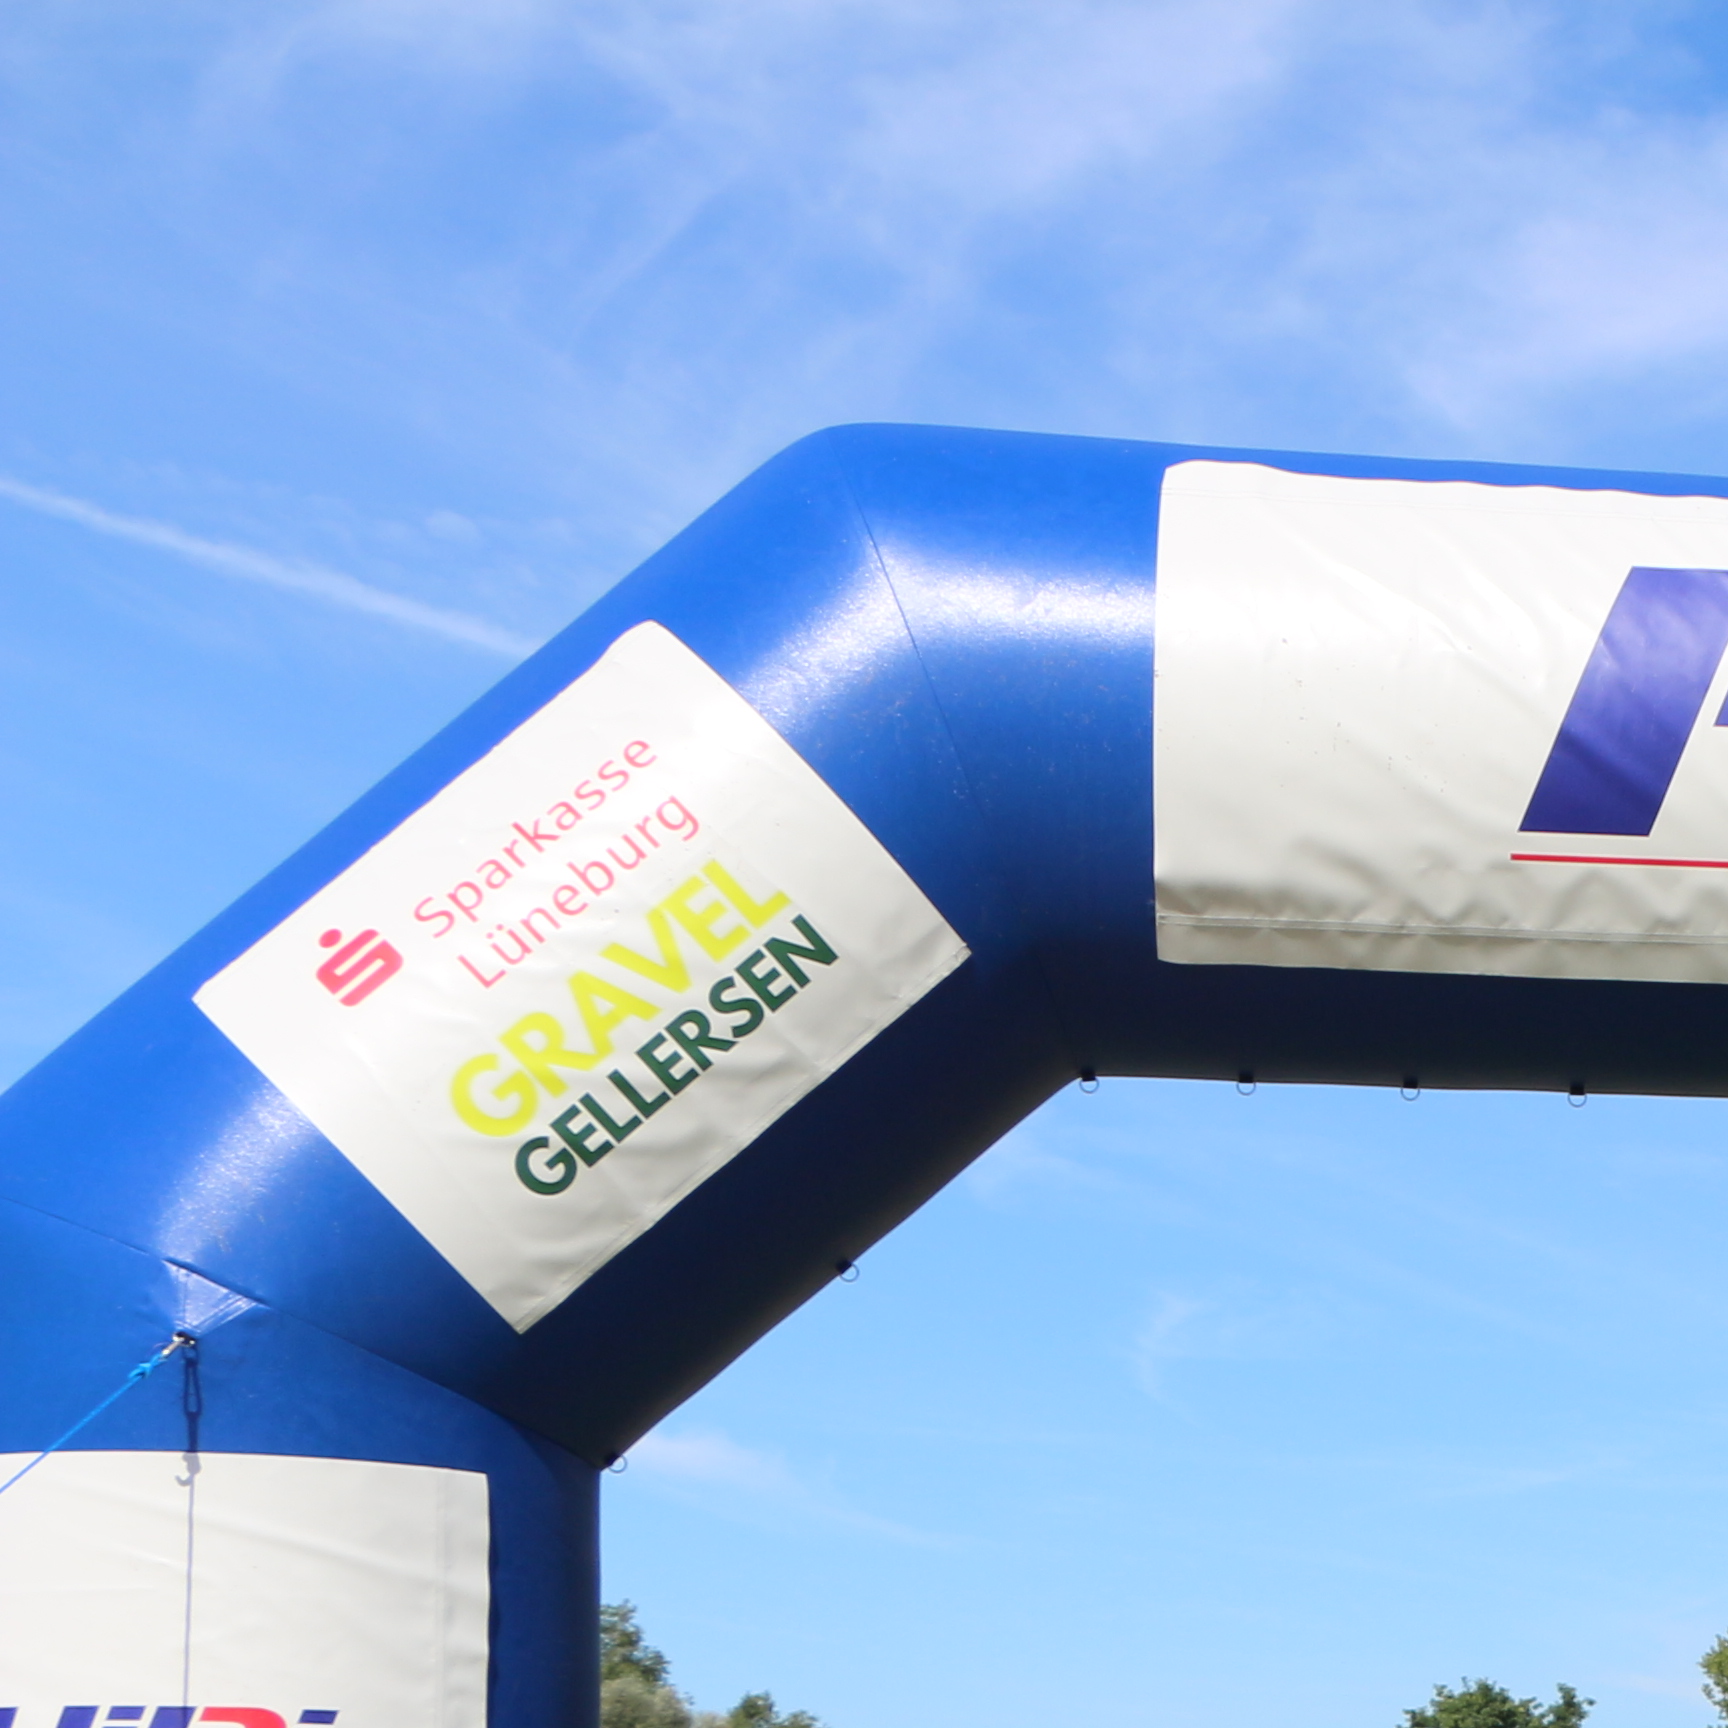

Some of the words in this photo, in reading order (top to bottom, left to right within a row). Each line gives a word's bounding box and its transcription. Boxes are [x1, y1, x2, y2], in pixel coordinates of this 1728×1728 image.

[411, 734, 658, 939] Sparkasse
[456, 794, 701, 990] Lüneburg
[449, 859, 792, 1138] GRAVEL
[514, 915, 841, 1196] GELLERSEN
